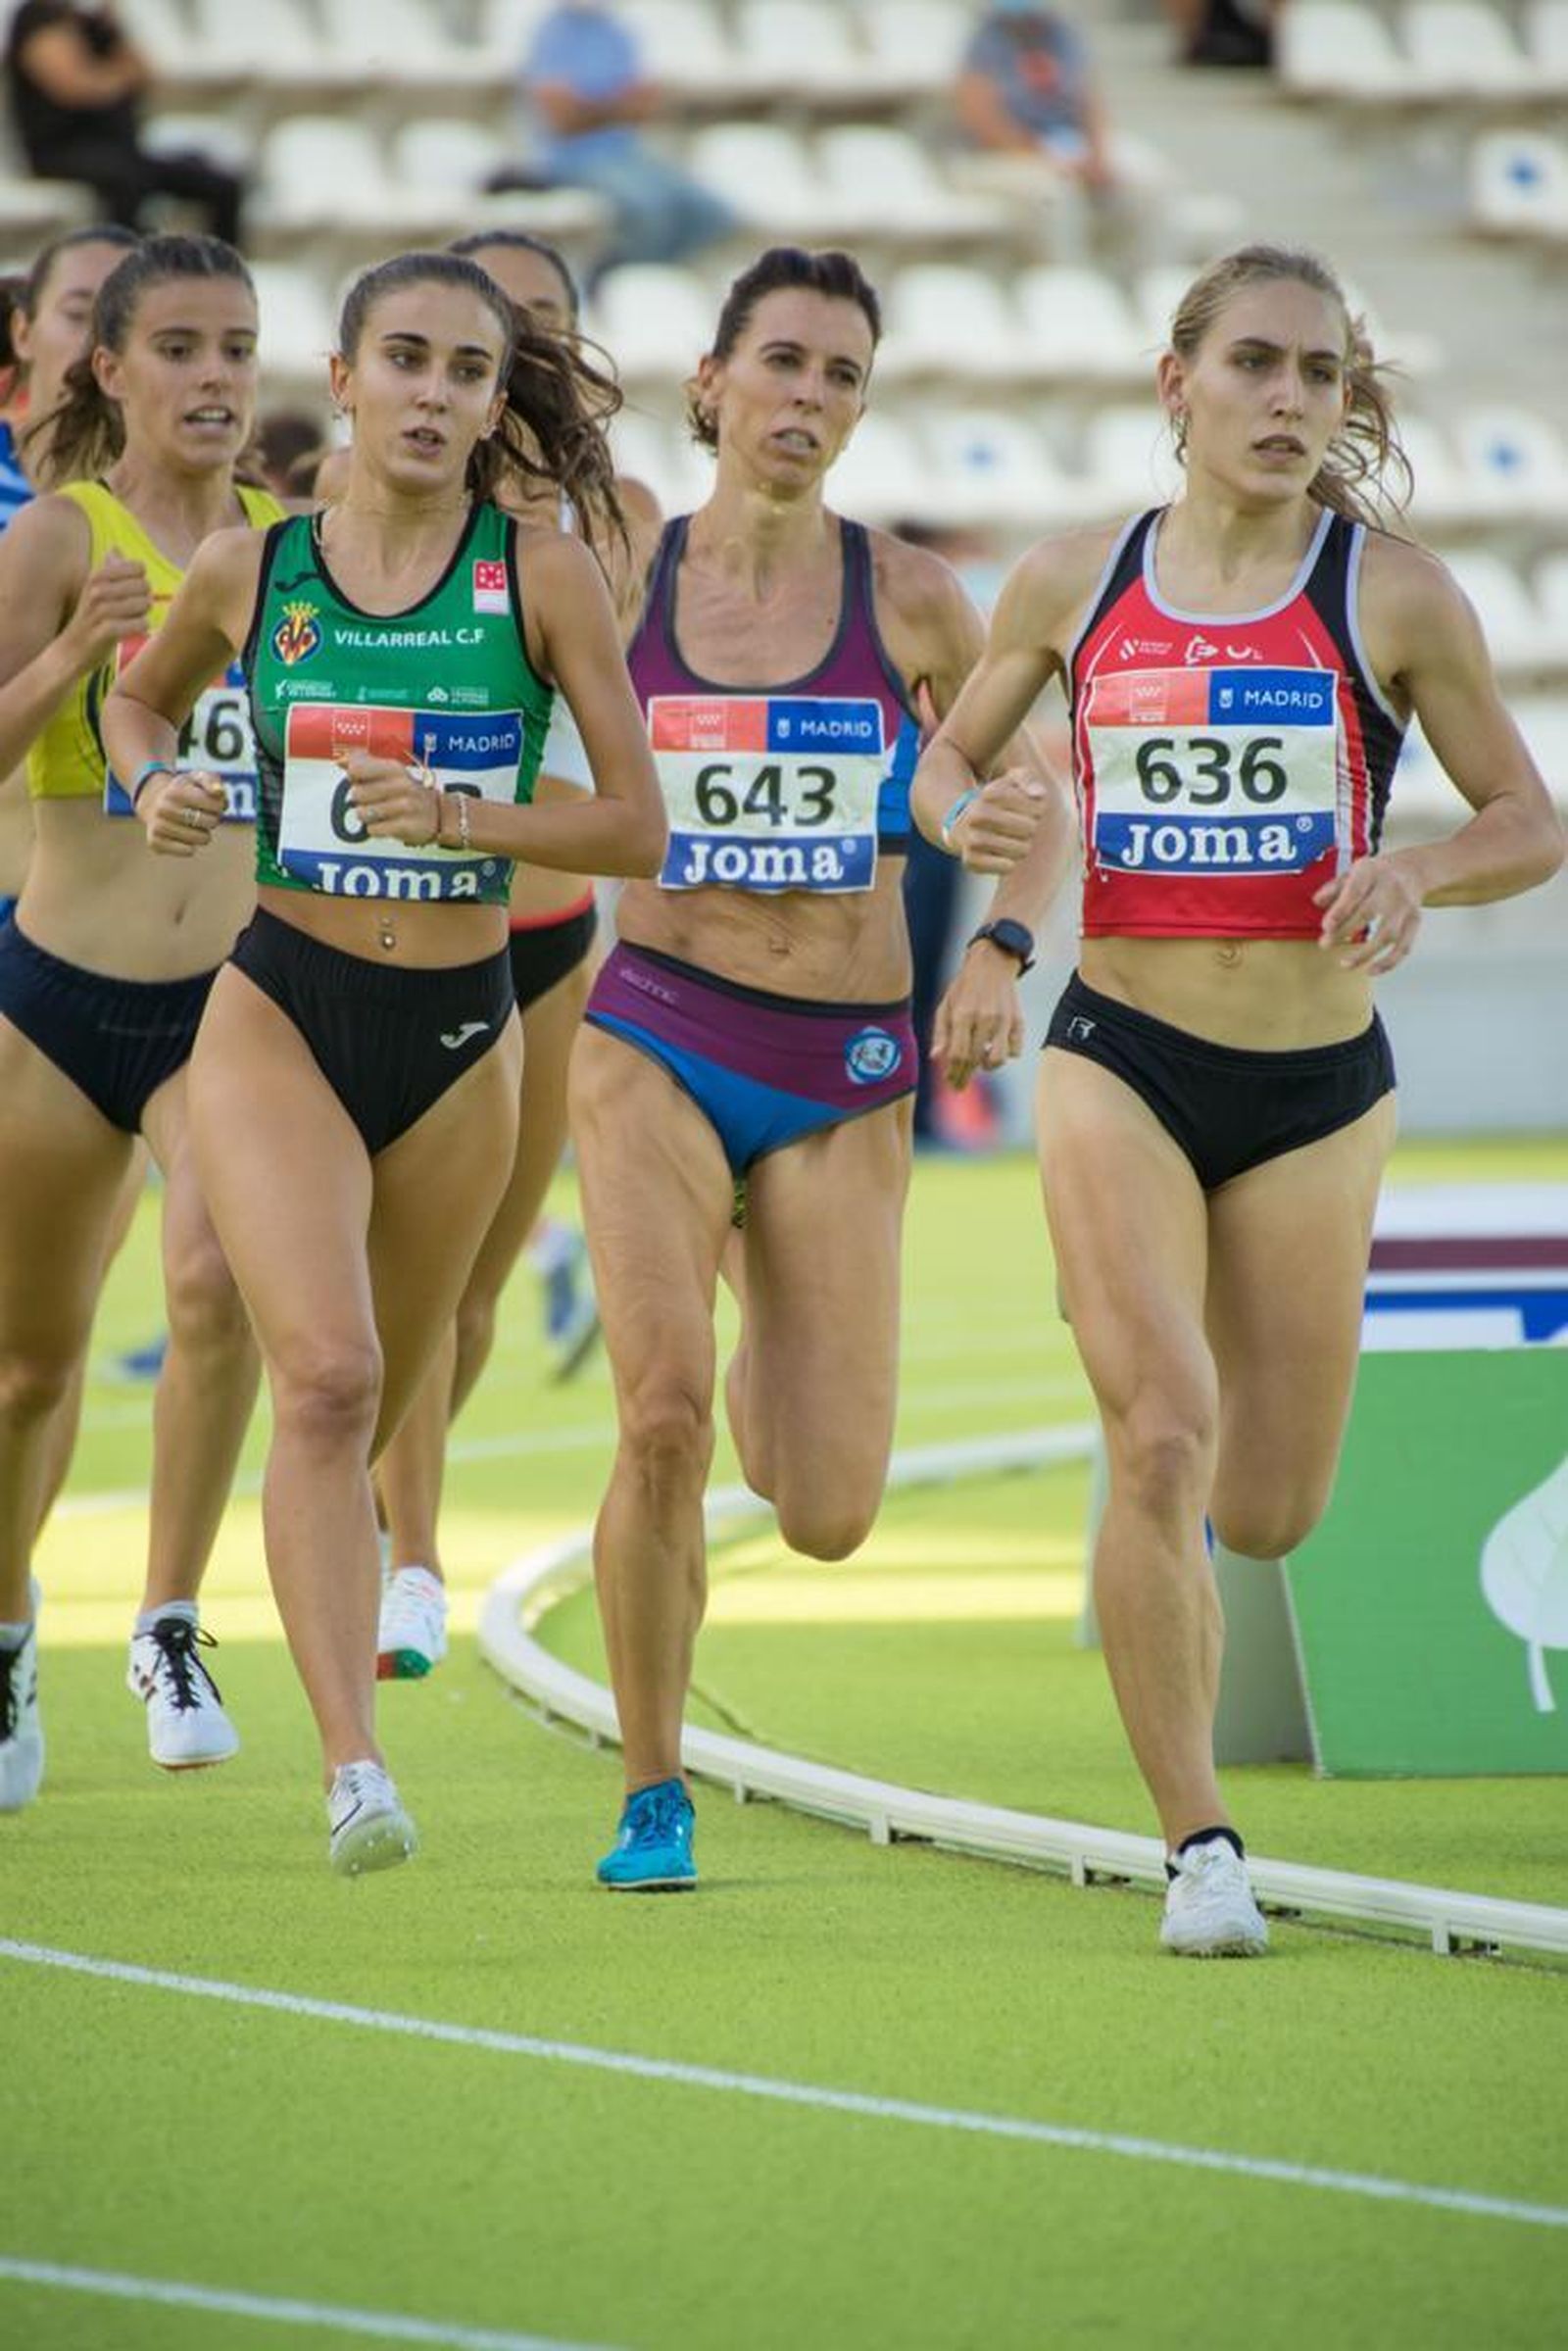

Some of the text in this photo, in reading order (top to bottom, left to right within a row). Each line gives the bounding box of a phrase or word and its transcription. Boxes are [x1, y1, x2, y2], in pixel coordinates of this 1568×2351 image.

[334, 629, 452, 647] VILLARREAL
[1244, 689, 1323, 709] MADRID
[801, 719, 872, 737] MADRID
[448, 733, 514, 752] MADRID
[1135, 737, 1288, 806] 636
[695, 763, 837, 827] 643
